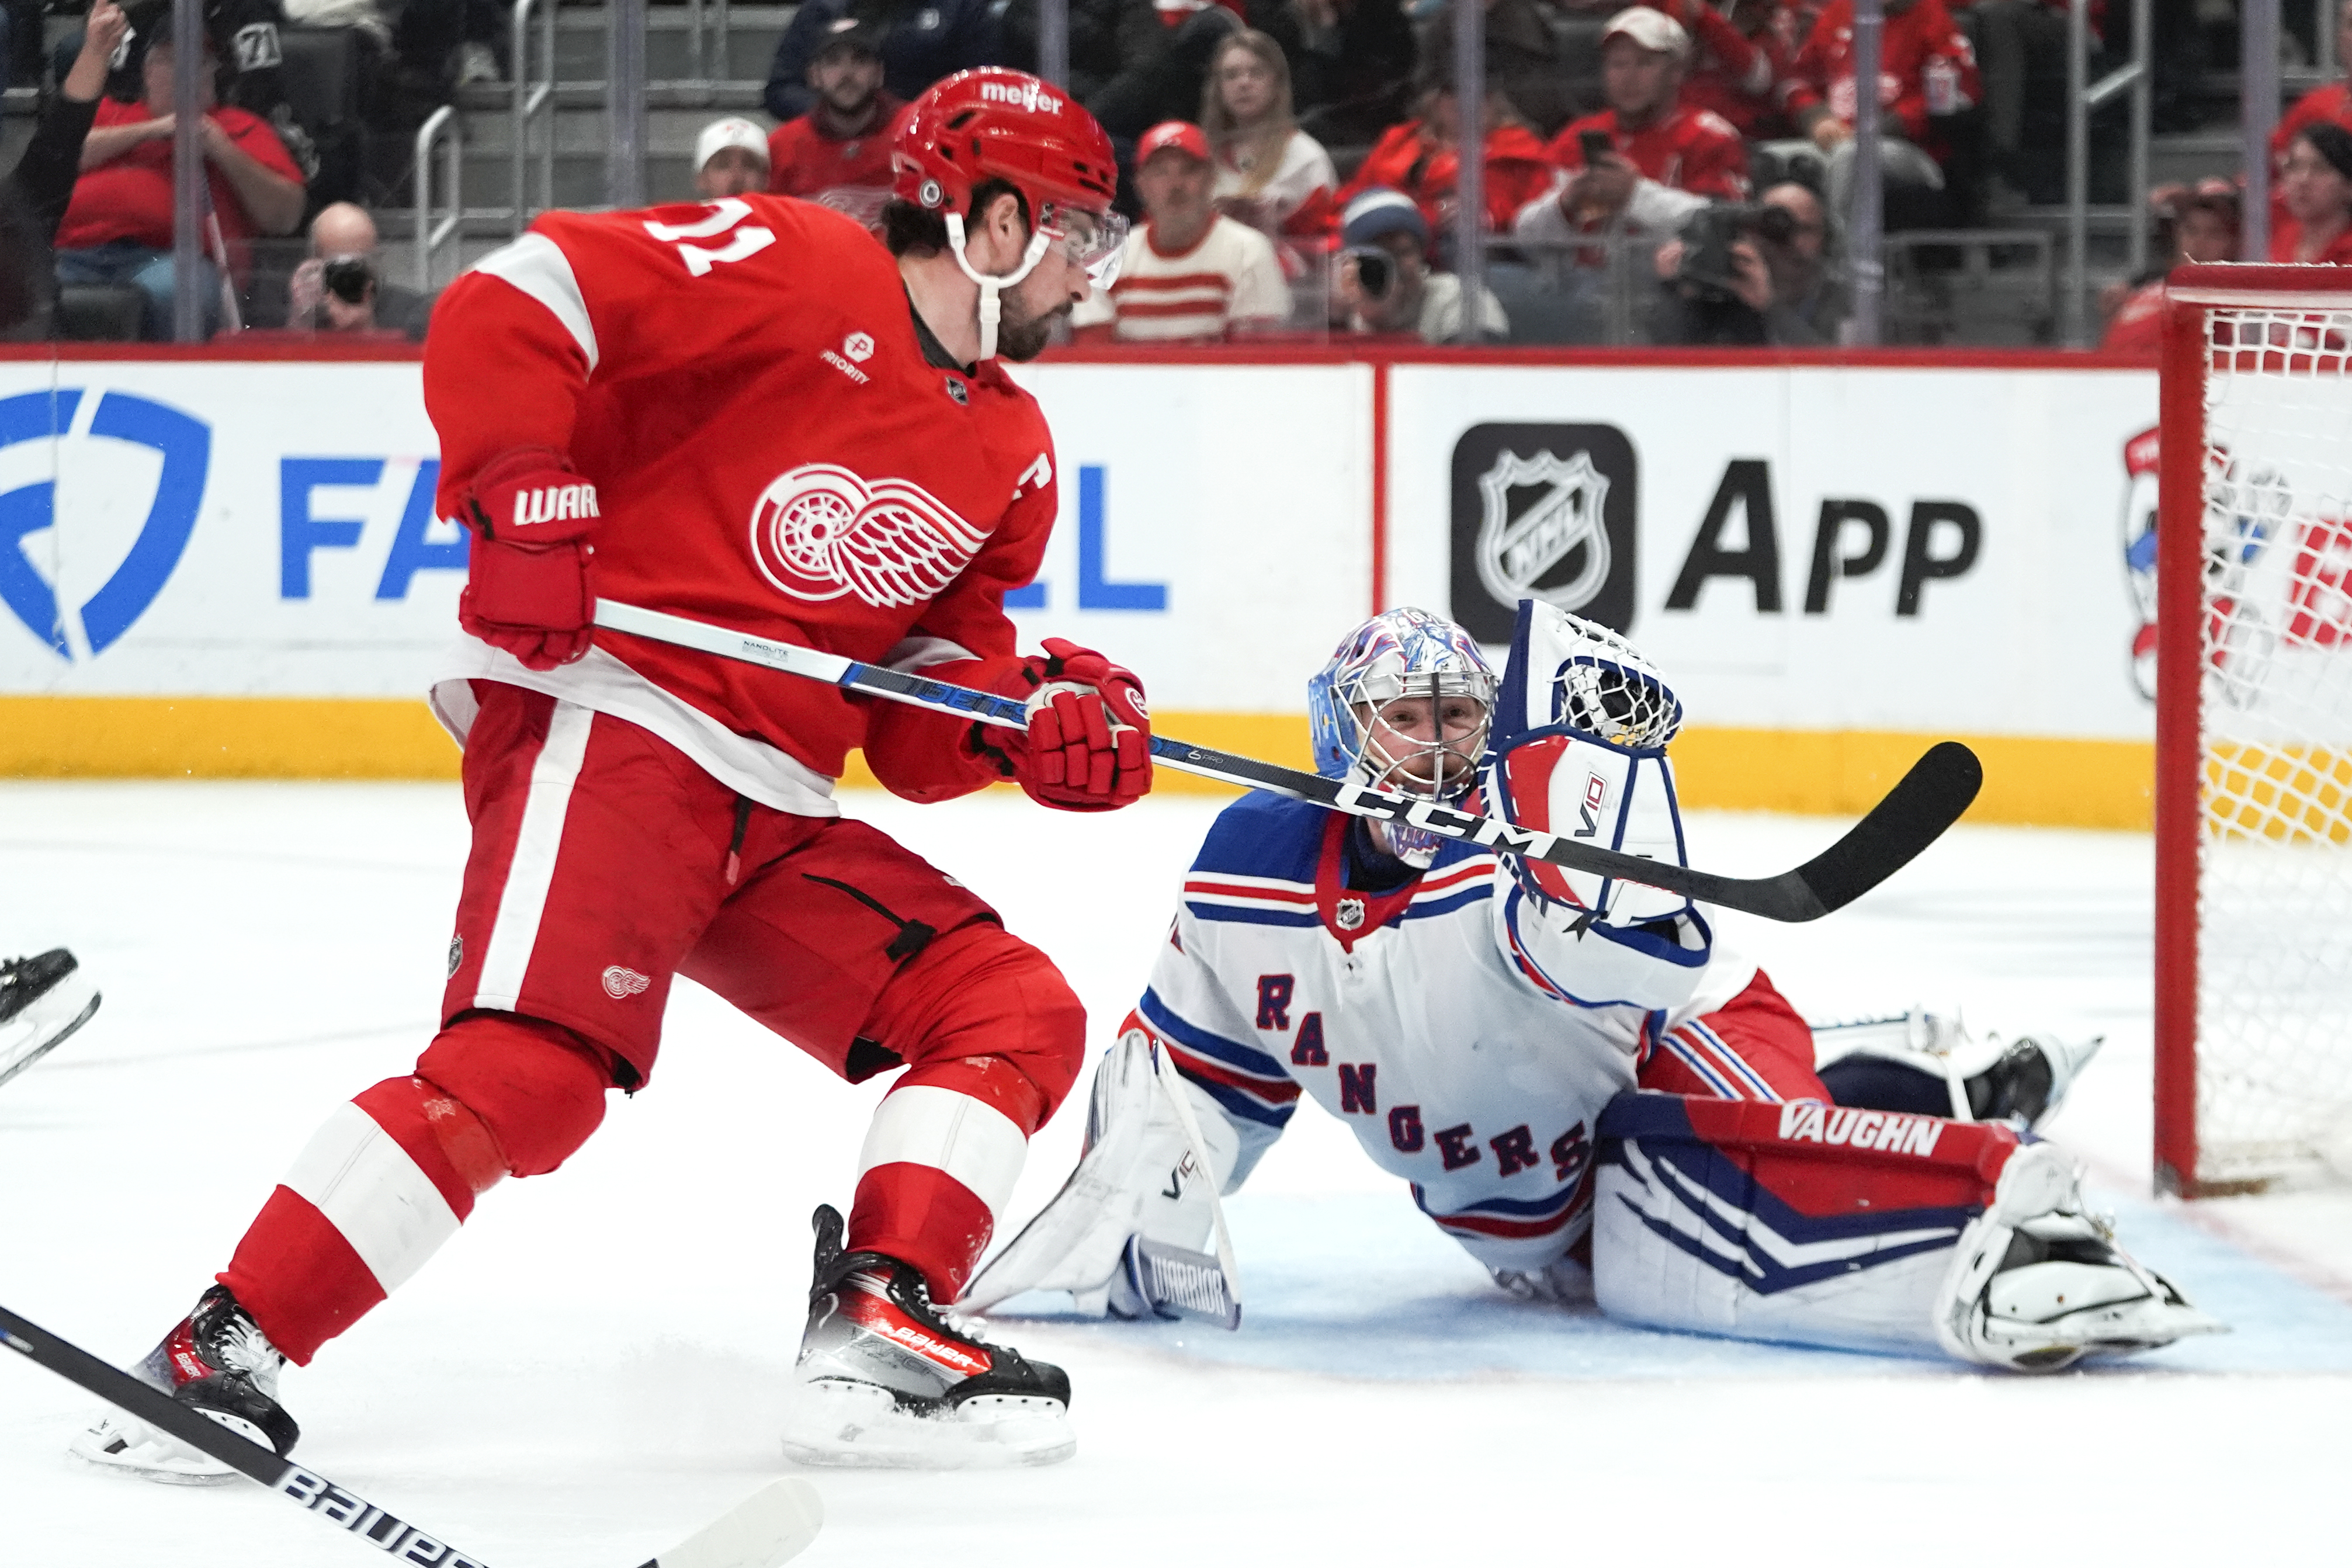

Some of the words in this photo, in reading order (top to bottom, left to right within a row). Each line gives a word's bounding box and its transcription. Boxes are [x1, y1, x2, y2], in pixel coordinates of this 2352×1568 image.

[982, 82, 1063, 116] meijer
[744, 641, 789, 655] NANOLITE
[1334, 783, 1558, 859] CCM
[1256, 973, 1591, 1182] RANGERS
[1778, 1103, 1944, 1157] VAUGHN
[1151, 1255, 1227, 1317] WARRIOR
